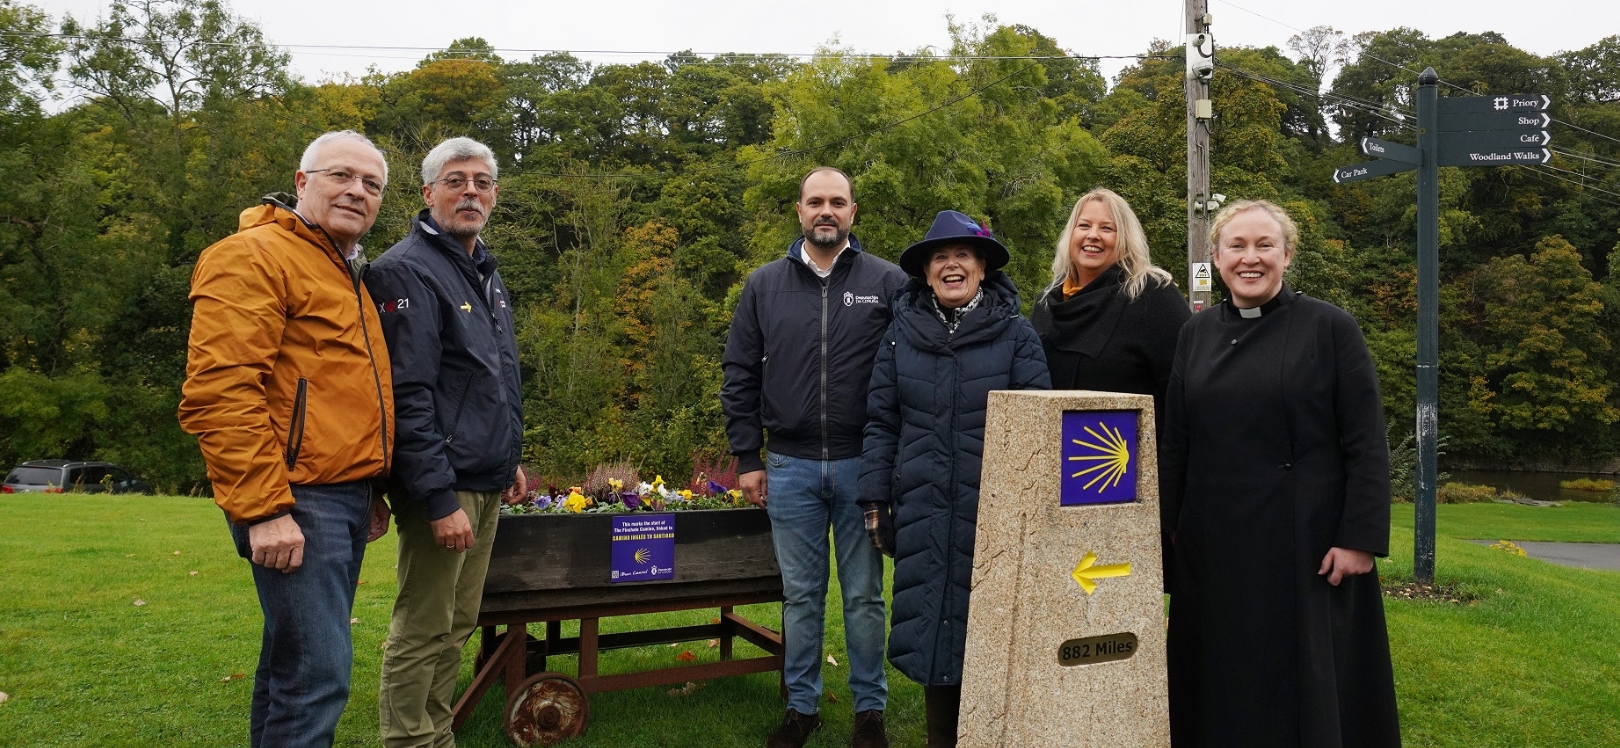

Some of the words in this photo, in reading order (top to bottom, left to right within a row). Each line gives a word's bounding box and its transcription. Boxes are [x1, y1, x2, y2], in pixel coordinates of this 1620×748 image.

[1512, 99, 1538, 108] Priory
[1518, 117, 1540, 125] Shop
[1520, 134, 1540, 142] Café
[1368, 142, 1385, 153] Toilets
[1470, 152, 1511, 160] Woodland
[1514, 152, 1540, 160] Walks
[1341, 170, 1352, 178] Car
[1354, 168, 1368, 176] Park
[397, 298, 409, 308] 21
[1063, 644, 1090, 660] 882
[1095, 641, 1133, 656] Miles
